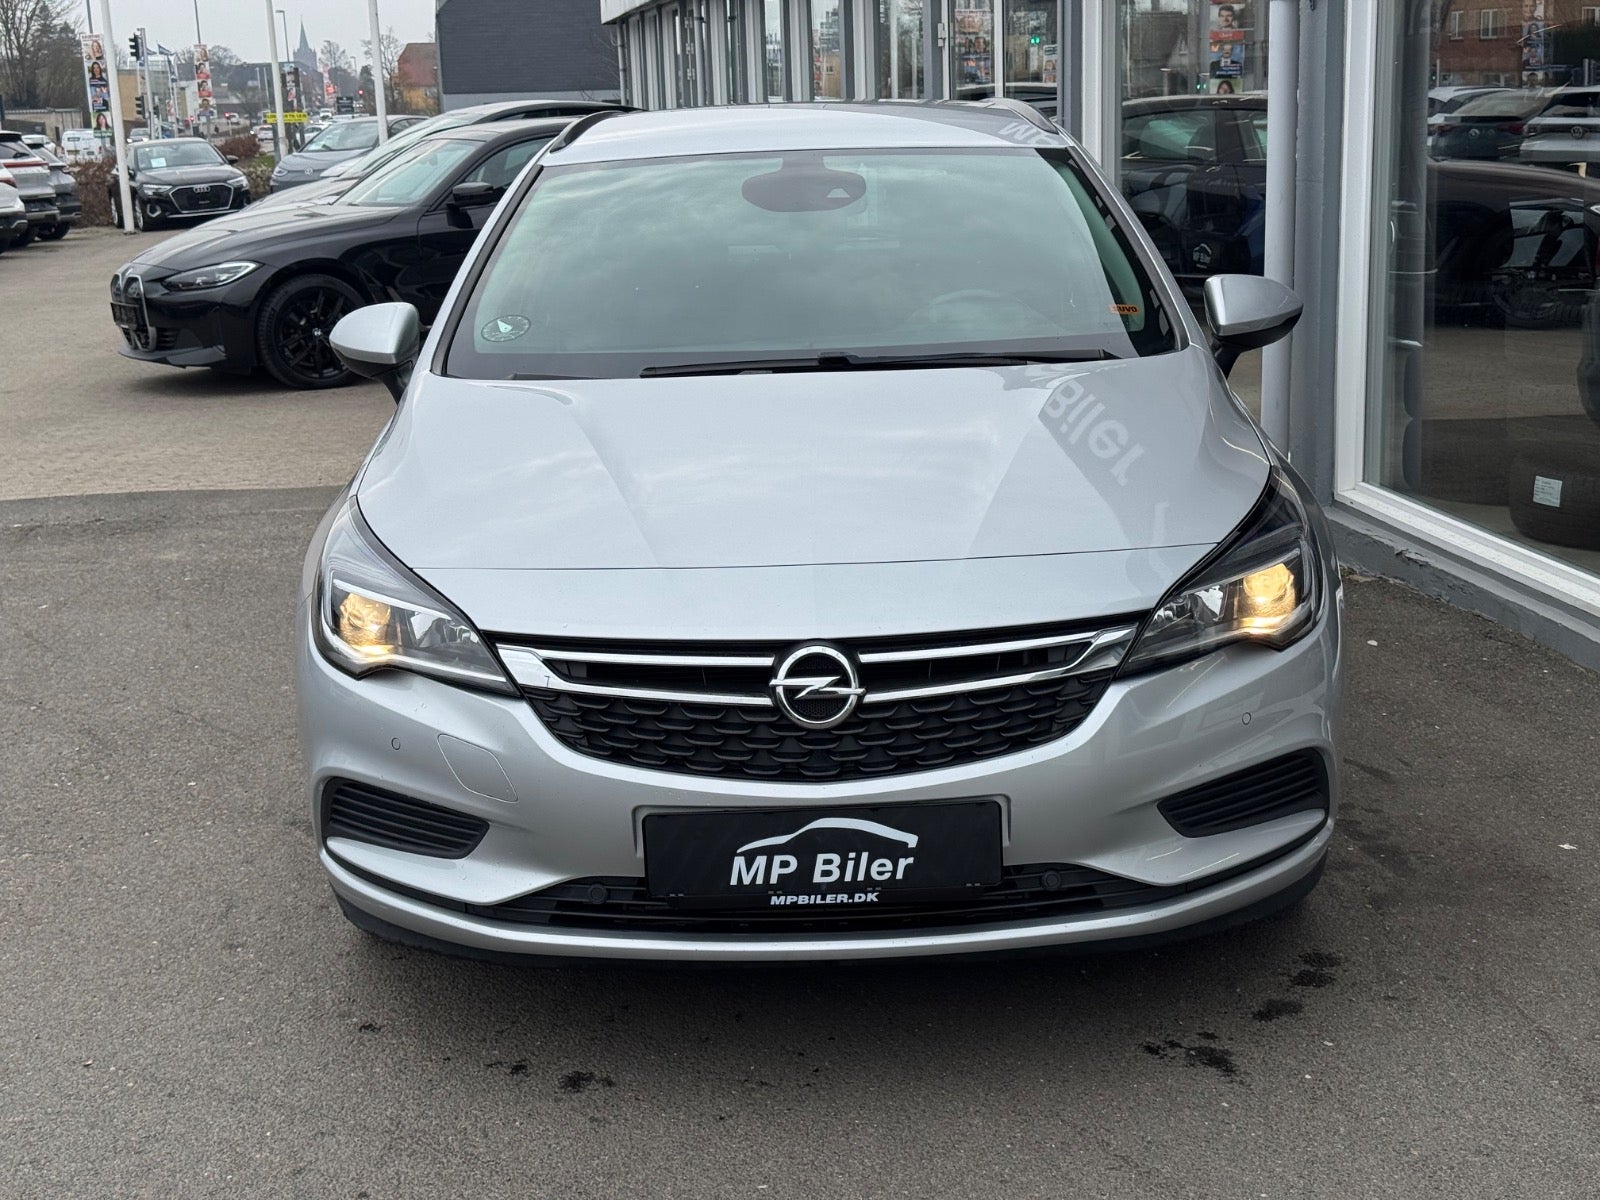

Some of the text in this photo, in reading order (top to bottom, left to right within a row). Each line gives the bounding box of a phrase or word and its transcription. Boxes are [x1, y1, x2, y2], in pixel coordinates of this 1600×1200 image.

[730, 852, 914, 886] MP Biler
[770, 892, 879, 905] MPBILER.DK
